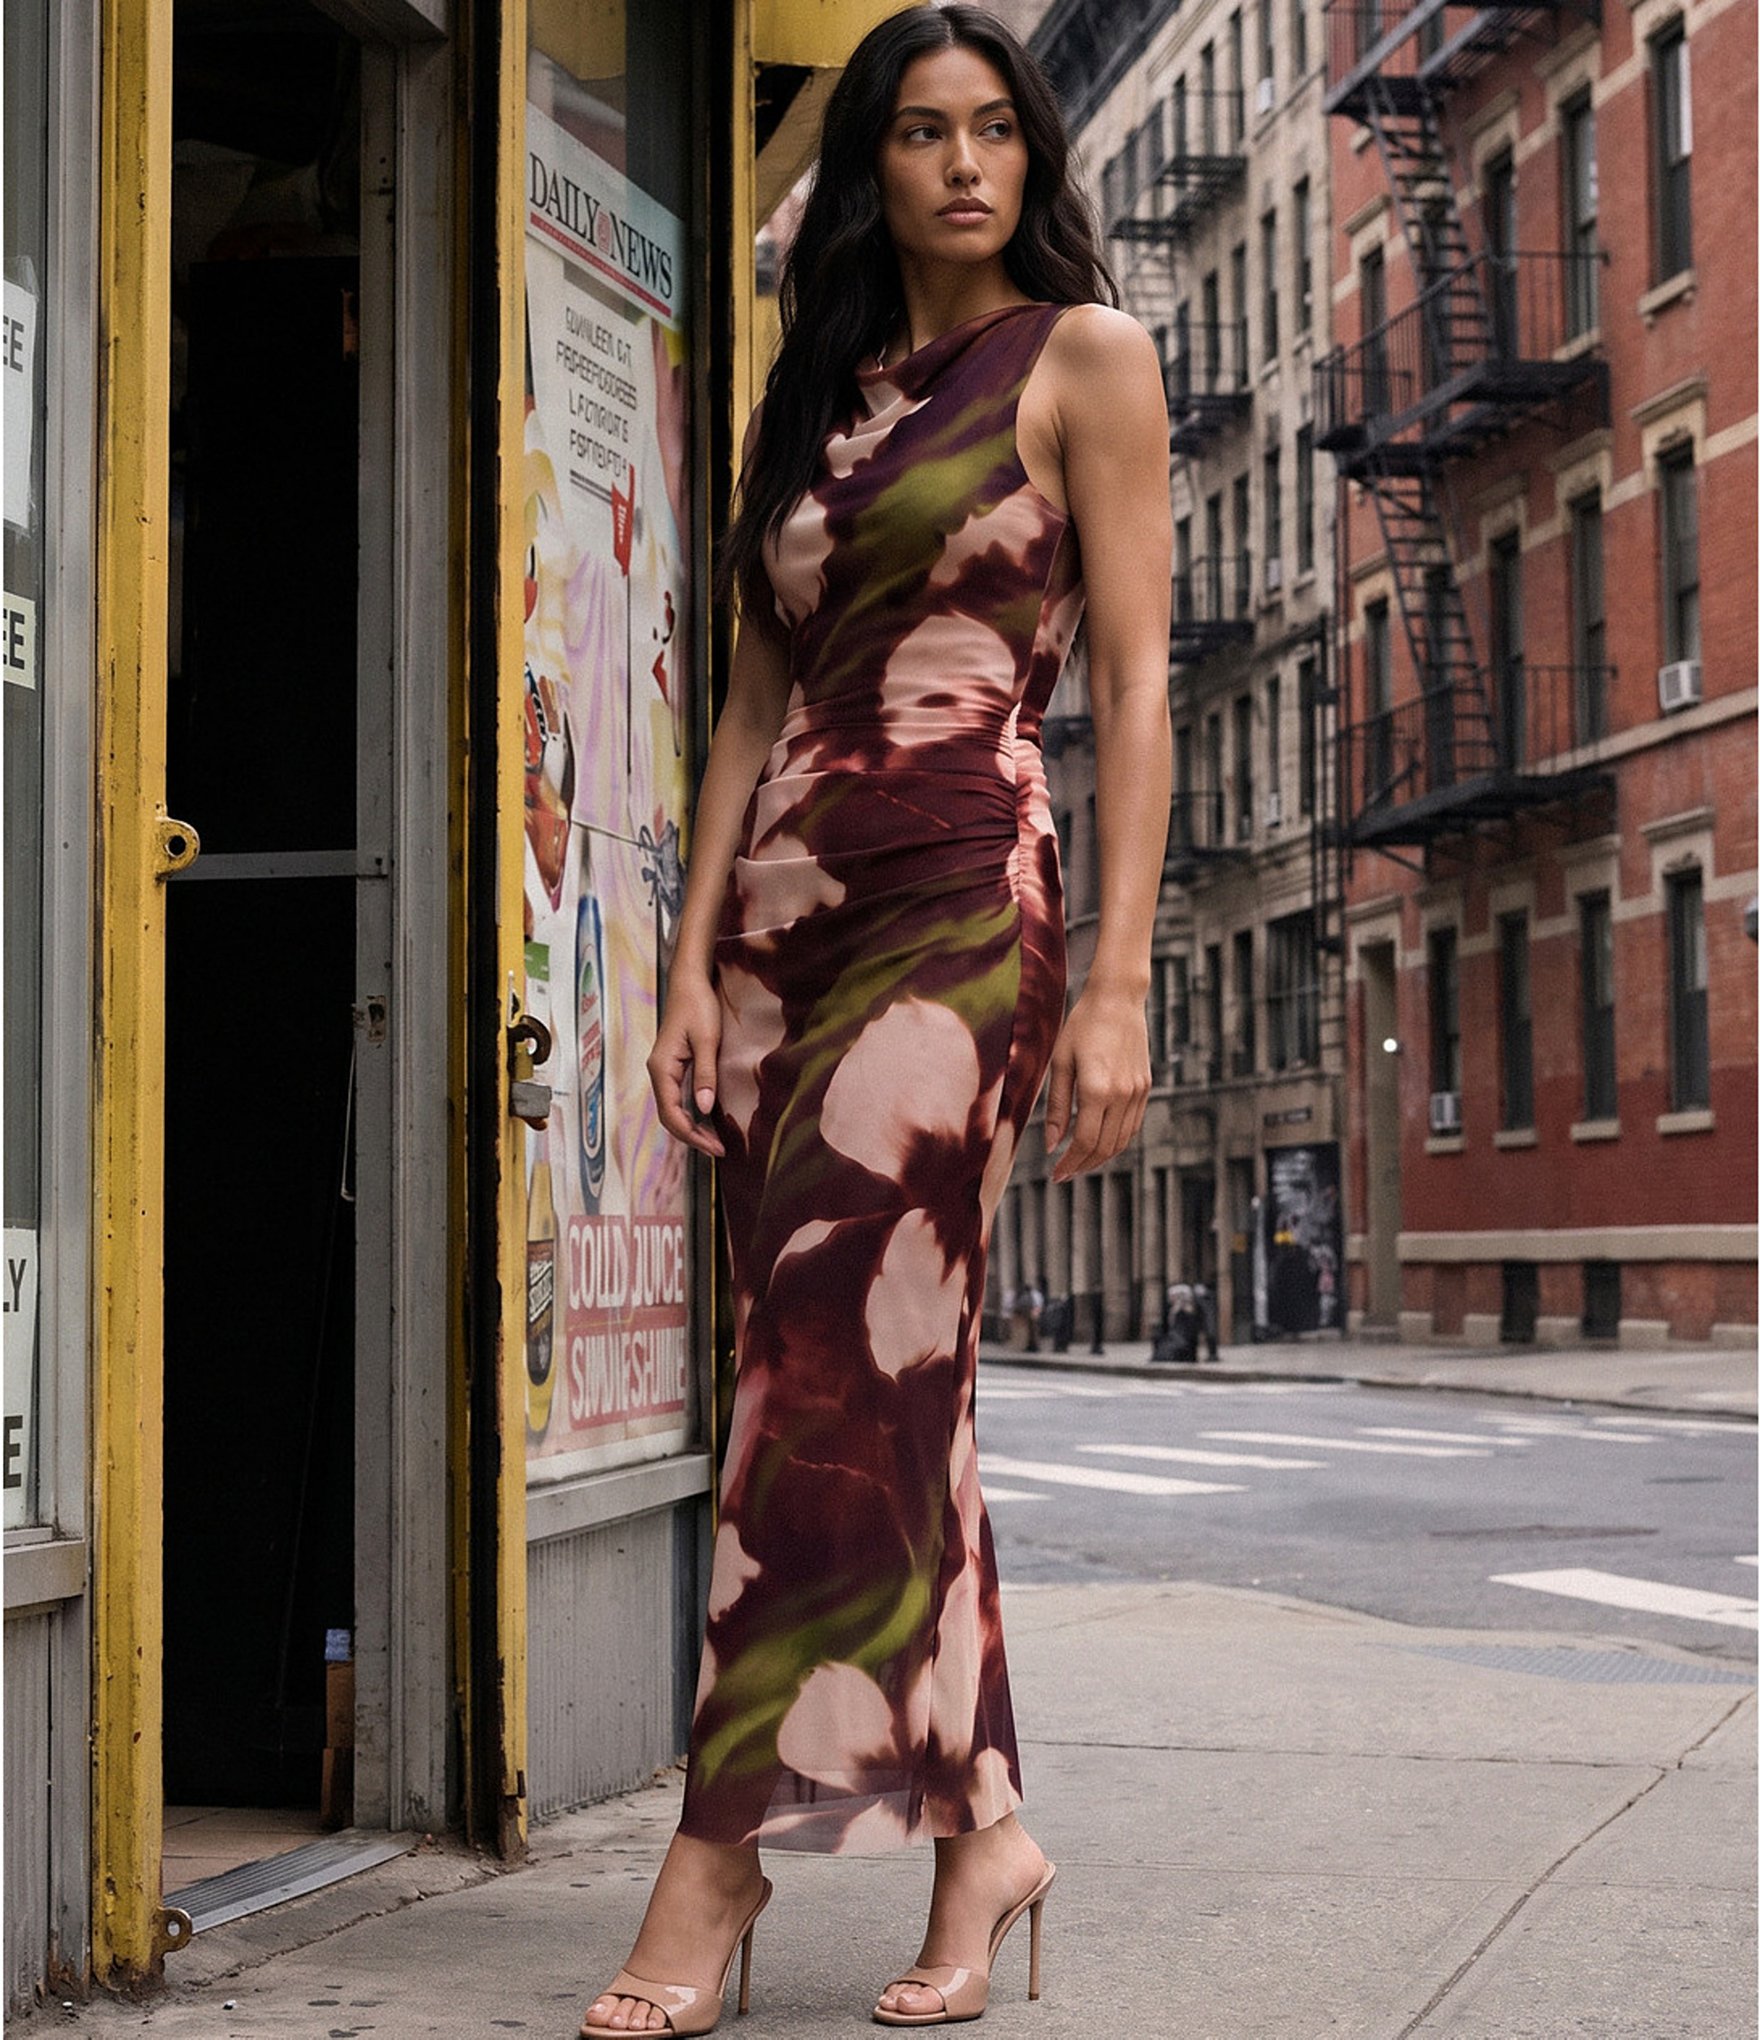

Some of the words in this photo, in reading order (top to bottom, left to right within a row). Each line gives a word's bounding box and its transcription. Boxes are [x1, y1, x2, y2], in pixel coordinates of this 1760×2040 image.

[530, 152, 600, 247] DAILY
[609, 210, 672, 299] NEWS
[3, 608, 25, 670] E
[631, 1224, 684, 1308] JUICE
